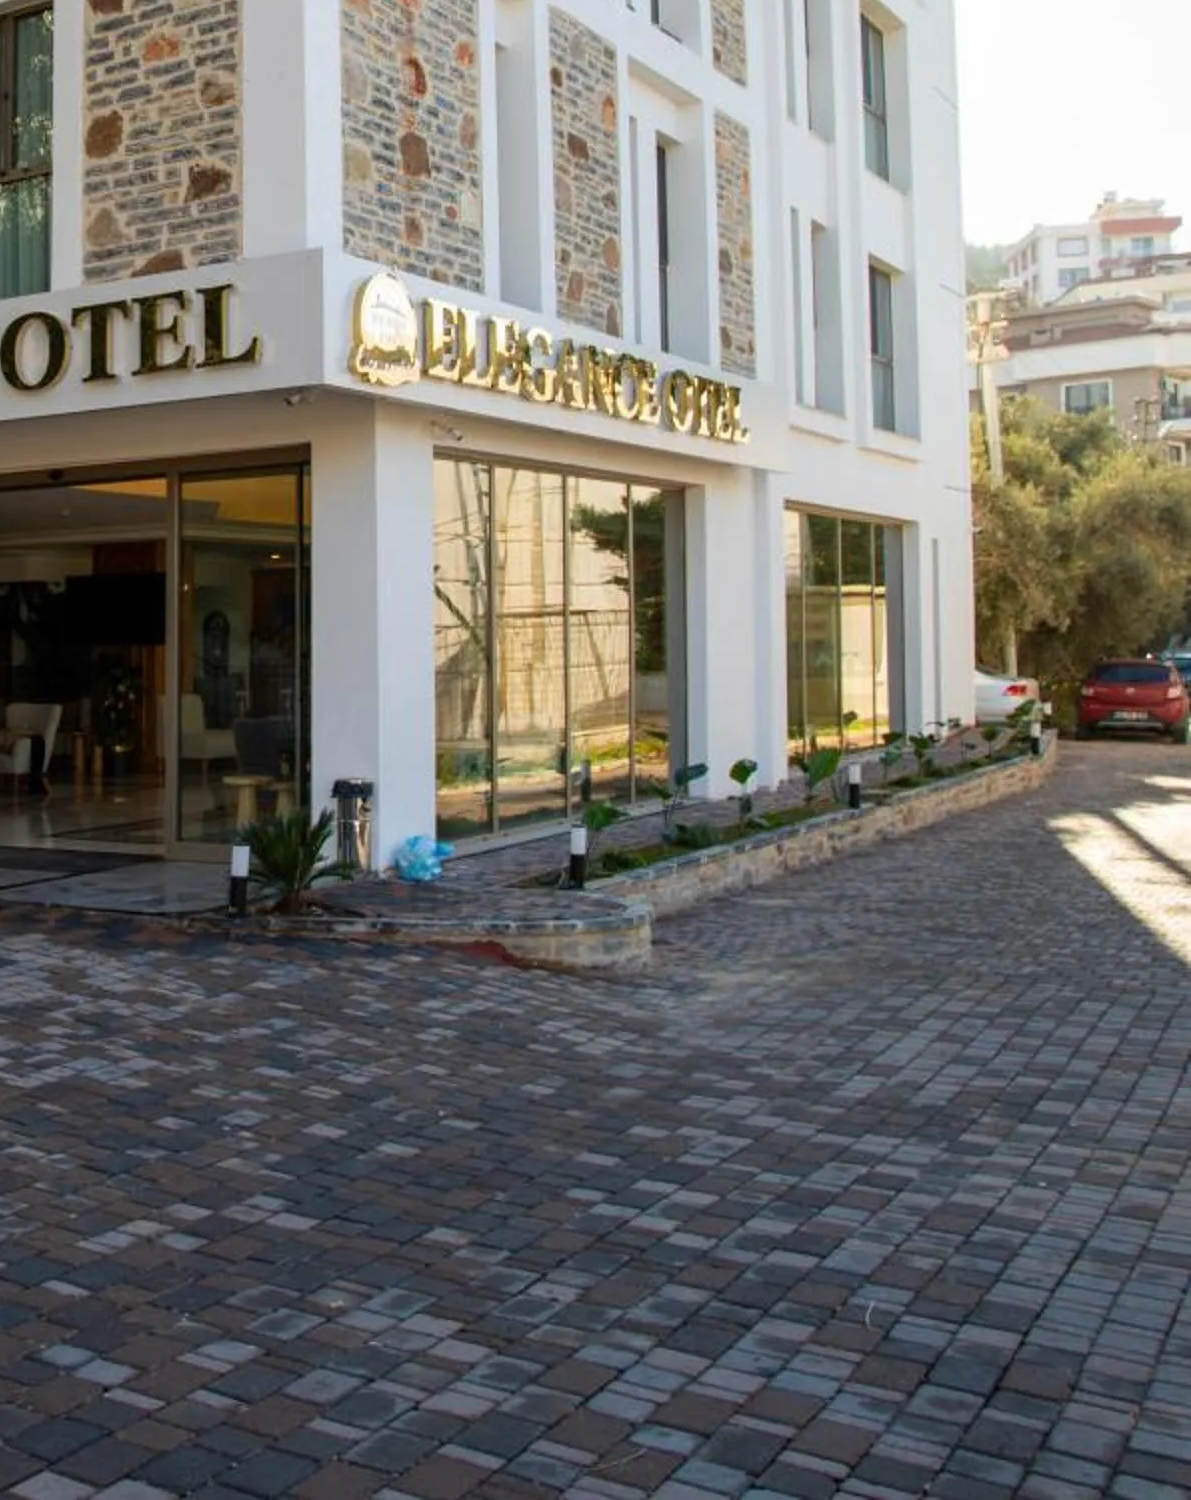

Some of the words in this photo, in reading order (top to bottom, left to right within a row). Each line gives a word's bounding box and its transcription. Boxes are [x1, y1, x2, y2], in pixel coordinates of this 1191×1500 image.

[0, 284, 261, 391] OTEL
[423, 297, 661, 425] ELEGANCE
[662, 369, 751, 445] OTEL
